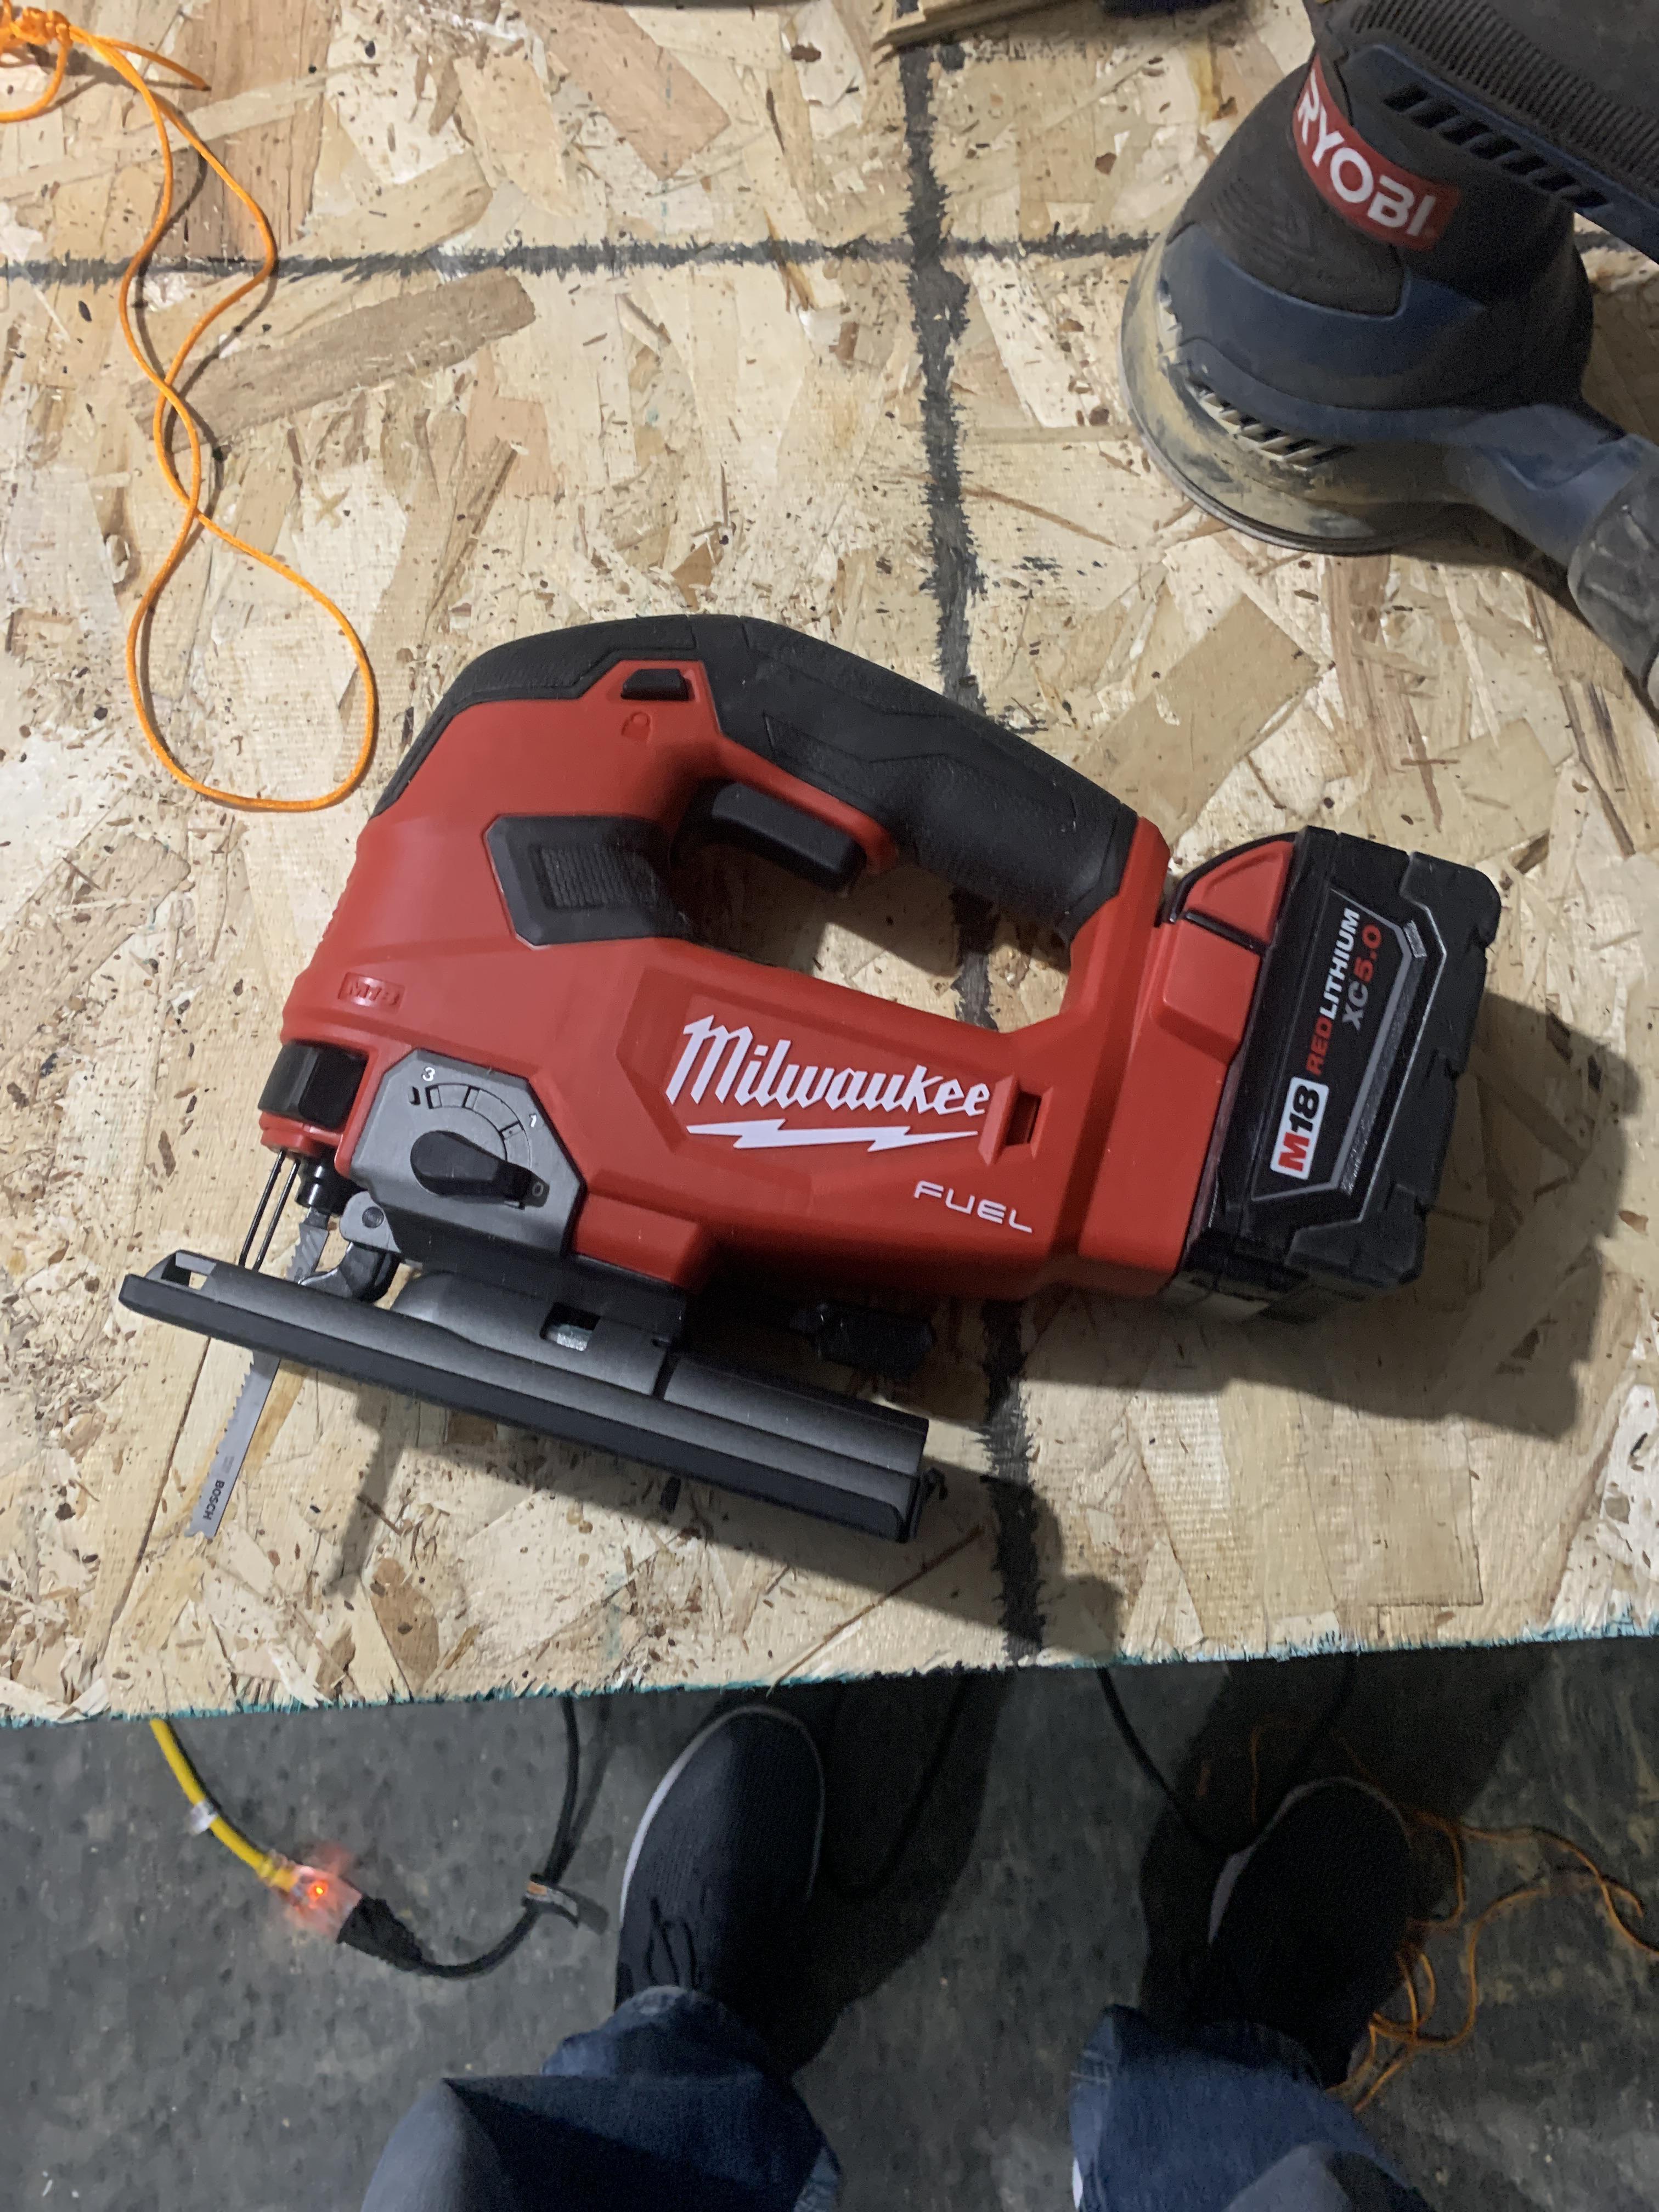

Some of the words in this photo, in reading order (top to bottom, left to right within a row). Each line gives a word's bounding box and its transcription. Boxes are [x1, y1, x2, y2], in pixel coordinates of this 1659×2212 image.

[1297, 68, 1436, 236] RYOBI
[422, 1068, 436, 1081] 3
[665, 1015, 990, 1116] Milwaukee
[529, 1114, 538, 1127] 1
[1278, 1084, 1319, 1172] M18
[914, 1181, 1032, 1233] FUEL
[203, 1480, 224, 1520] BOSCH
